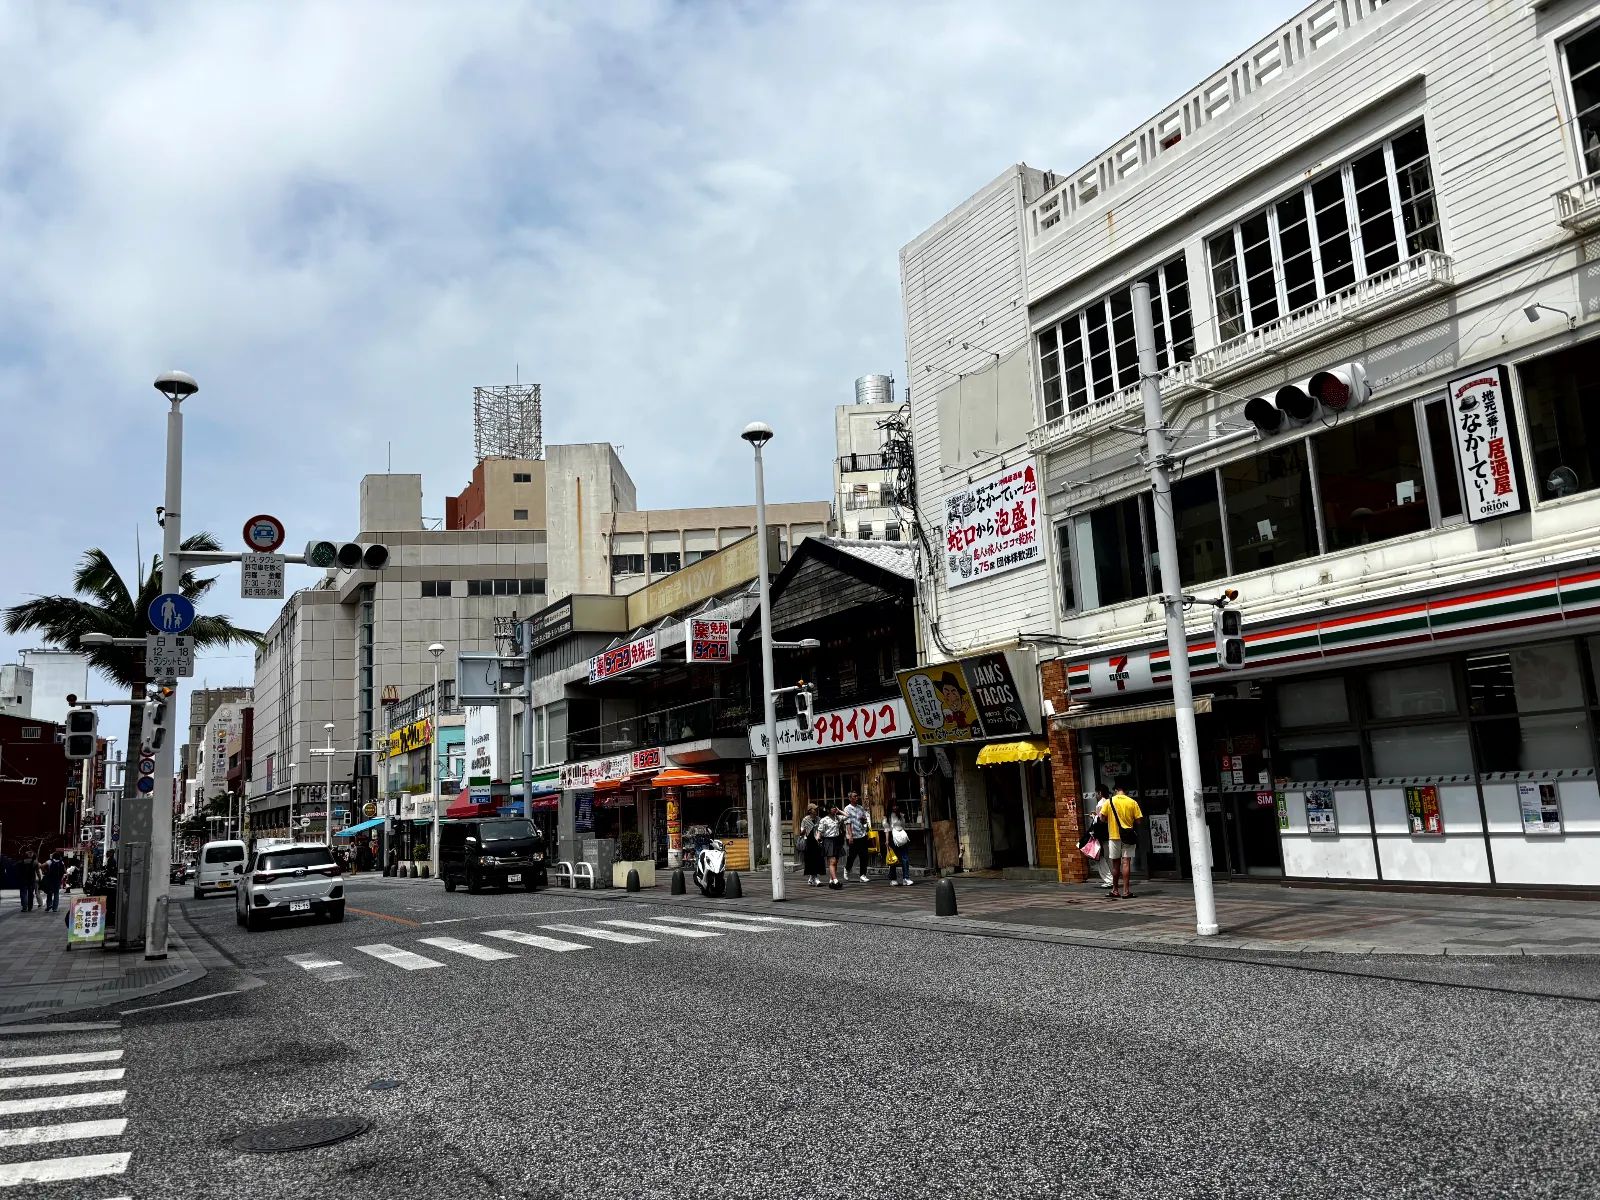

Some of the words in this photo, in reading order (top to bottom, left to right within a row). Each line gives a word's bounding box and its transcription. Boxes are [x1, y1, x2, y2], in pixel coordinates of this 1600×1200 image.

[1460, 413, 1489, 502] なかーてぃー
[1488, 437, 1513, 497] 居酒屋
[1025, 482, 1035, 491] 2F
[1480, 500, 1509, 514] ORION
[693, 621, 709, 639] 薬
[710, 622, 727, 634] 免税
[153, 647, 163, 656] 12
[179, 647, 189, 656] 18
[631, 641, 645, 665] 免税
[974, 660, 1004, 687] JAM'S
[976, 684, 1014, 707] TACOS
[1257, 795, 1273, 804] SIM
